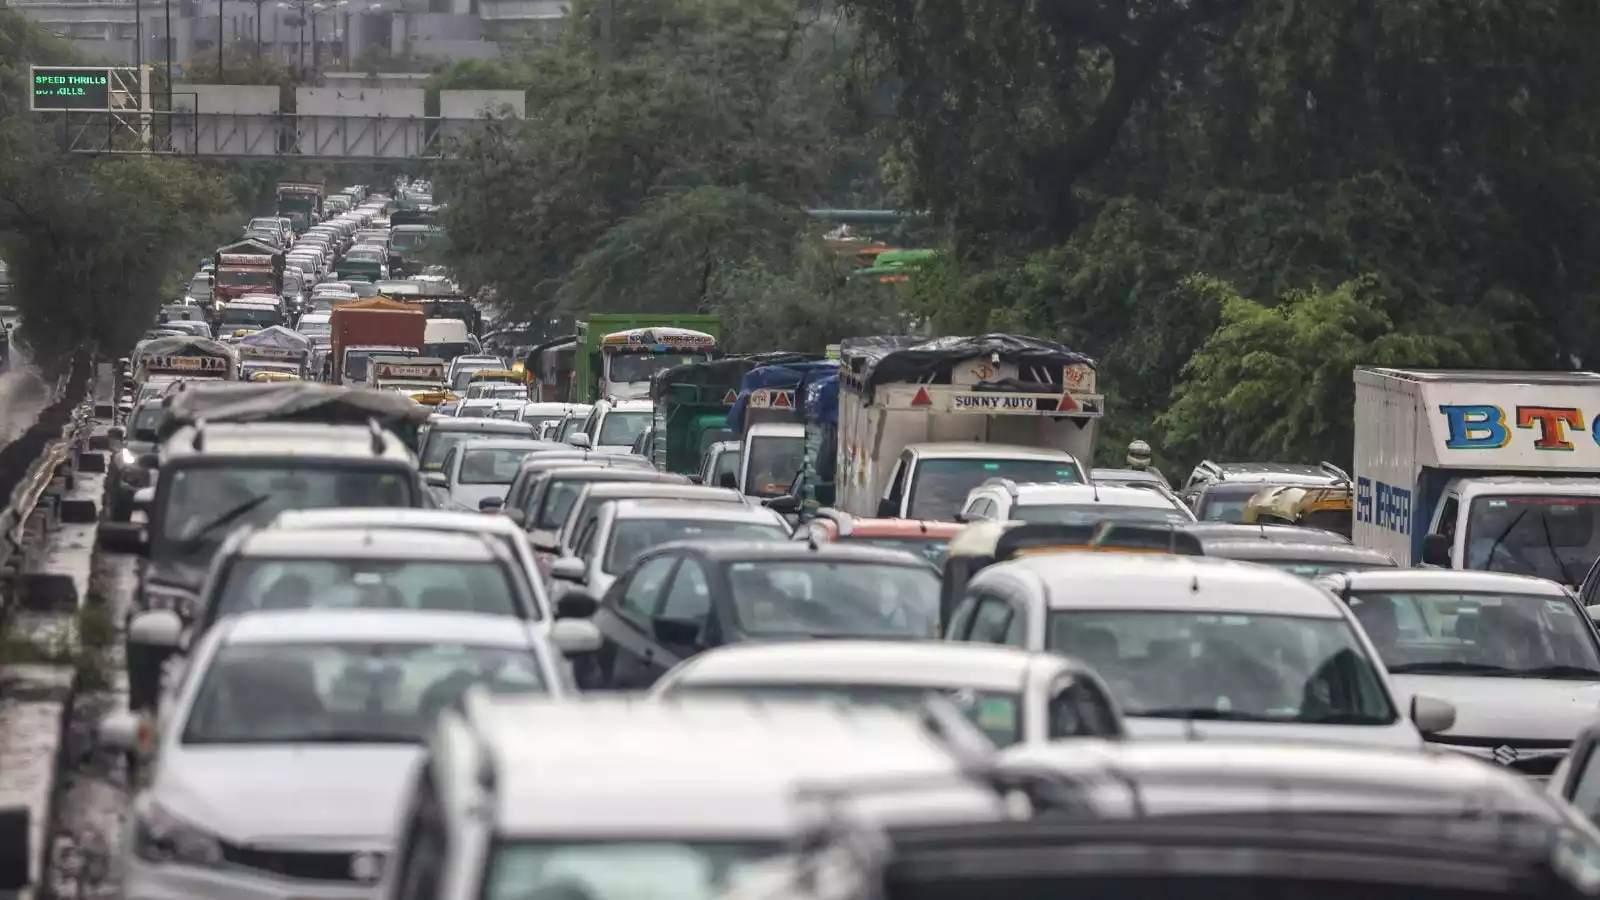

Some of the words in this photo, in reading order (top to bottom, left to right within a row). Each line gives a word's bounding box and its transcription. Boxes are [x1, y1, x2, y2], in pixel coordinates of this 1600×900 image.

[35, 76, 66, 84] SPEED
[68, 76, 107, 84] THRILLS
[955, 396, 1000, 408] SUNNY
[1003, 397, 1034, 408] AUTO
[1438, 404, 1600, 452] BT
